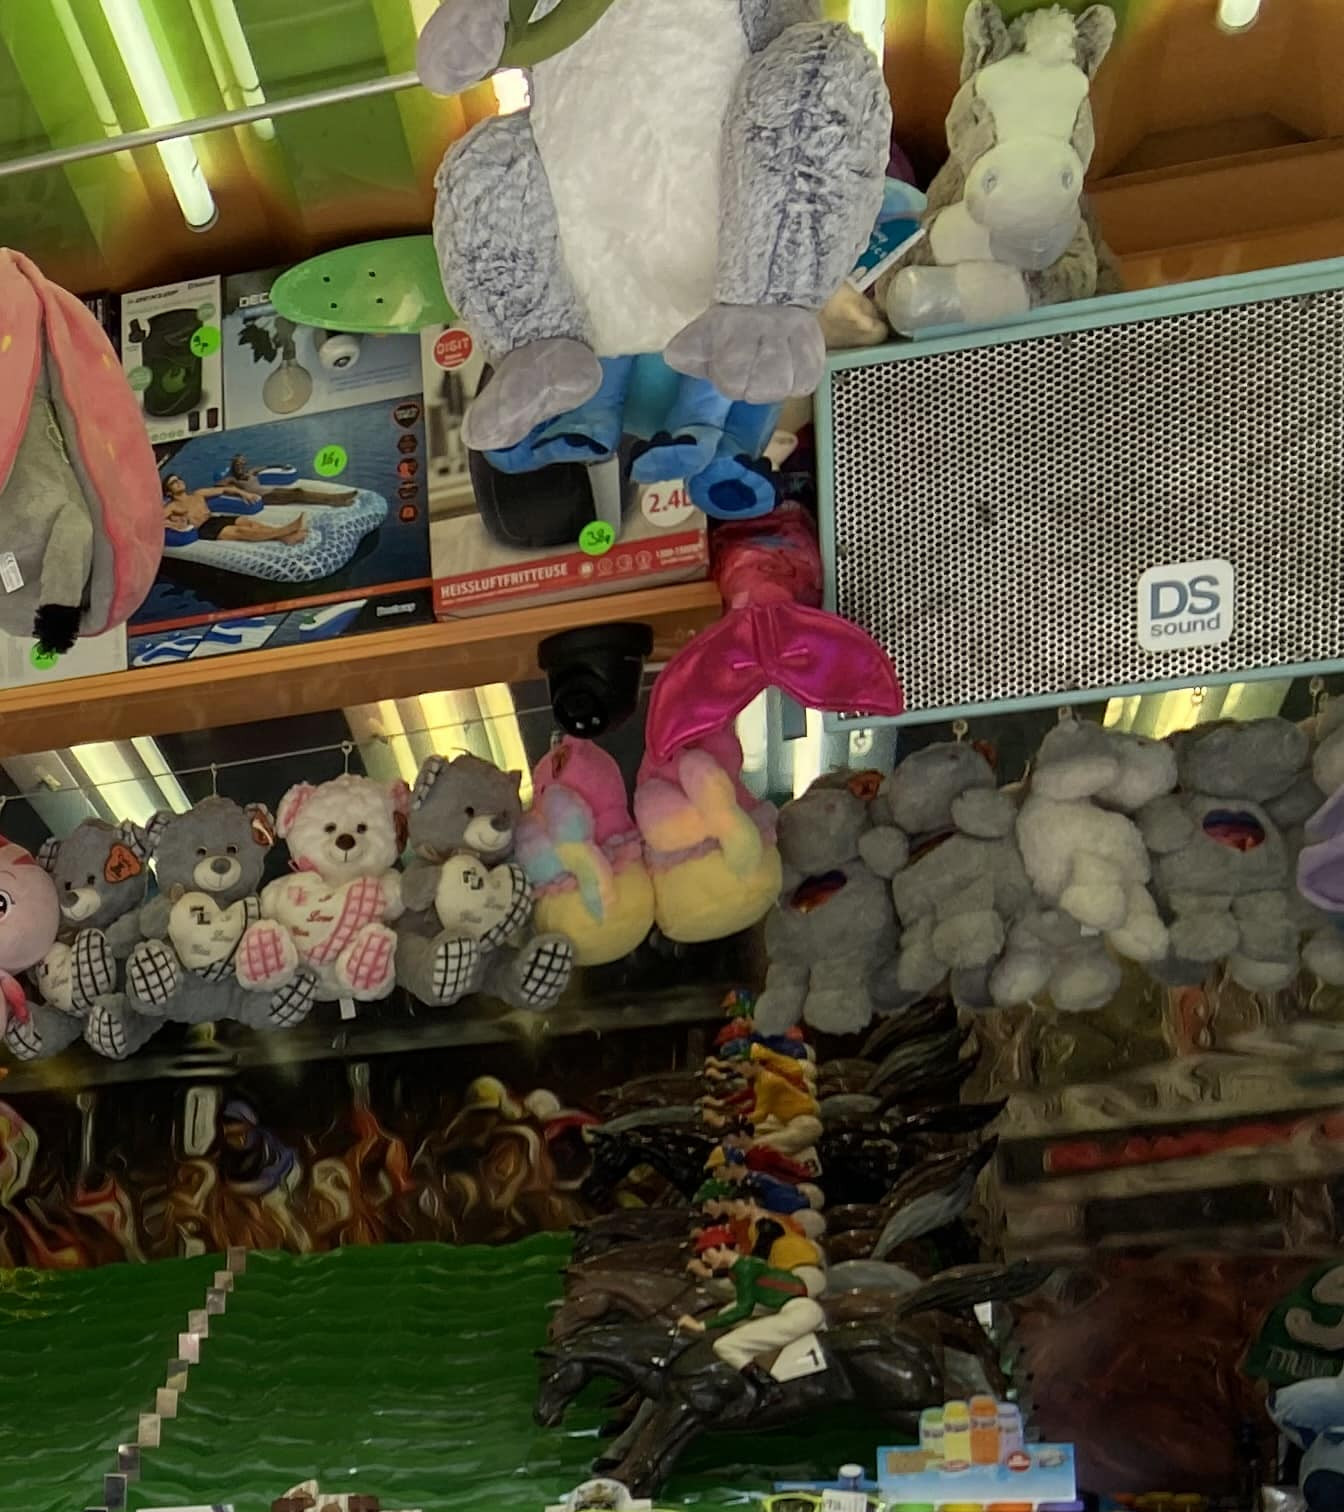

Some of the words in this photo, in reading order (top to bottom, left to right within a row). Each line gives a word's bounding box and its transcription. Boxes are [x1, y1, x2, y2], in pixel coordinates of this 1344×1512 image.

[440, 563, 569, 599] HEISSLUFTFRITTEUSE
[1149, 575, 1221, 621] DS
[1150, 613, 1222, 637] sound
